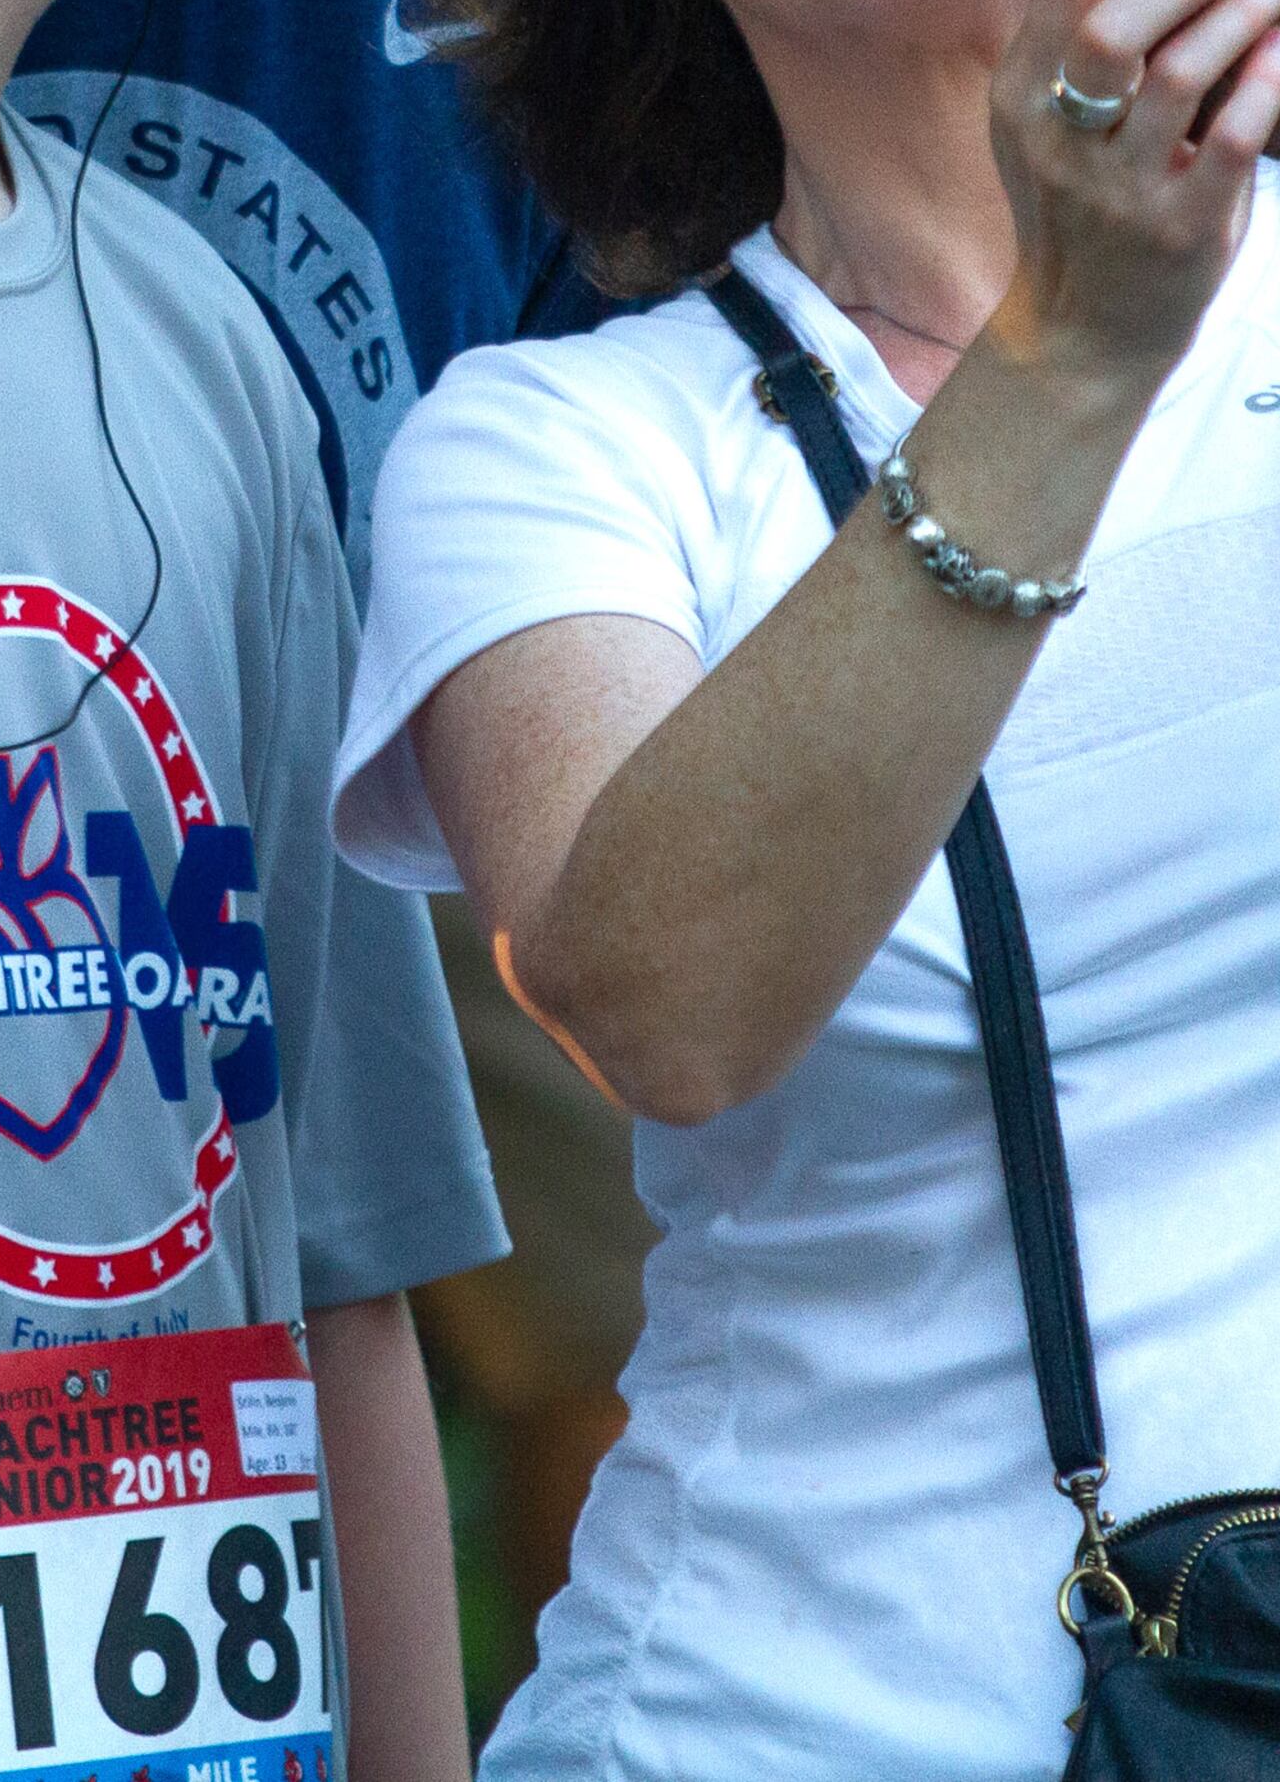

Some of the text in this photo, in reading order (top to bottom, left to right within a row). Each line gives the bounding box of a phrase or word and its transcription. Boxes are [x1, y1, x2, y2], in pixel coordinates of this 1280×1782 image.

[124, 119, 393, 402] STATES
[111, 1448, 211, 1506] 2019
[186, 1755, 257, 1782] MILE
